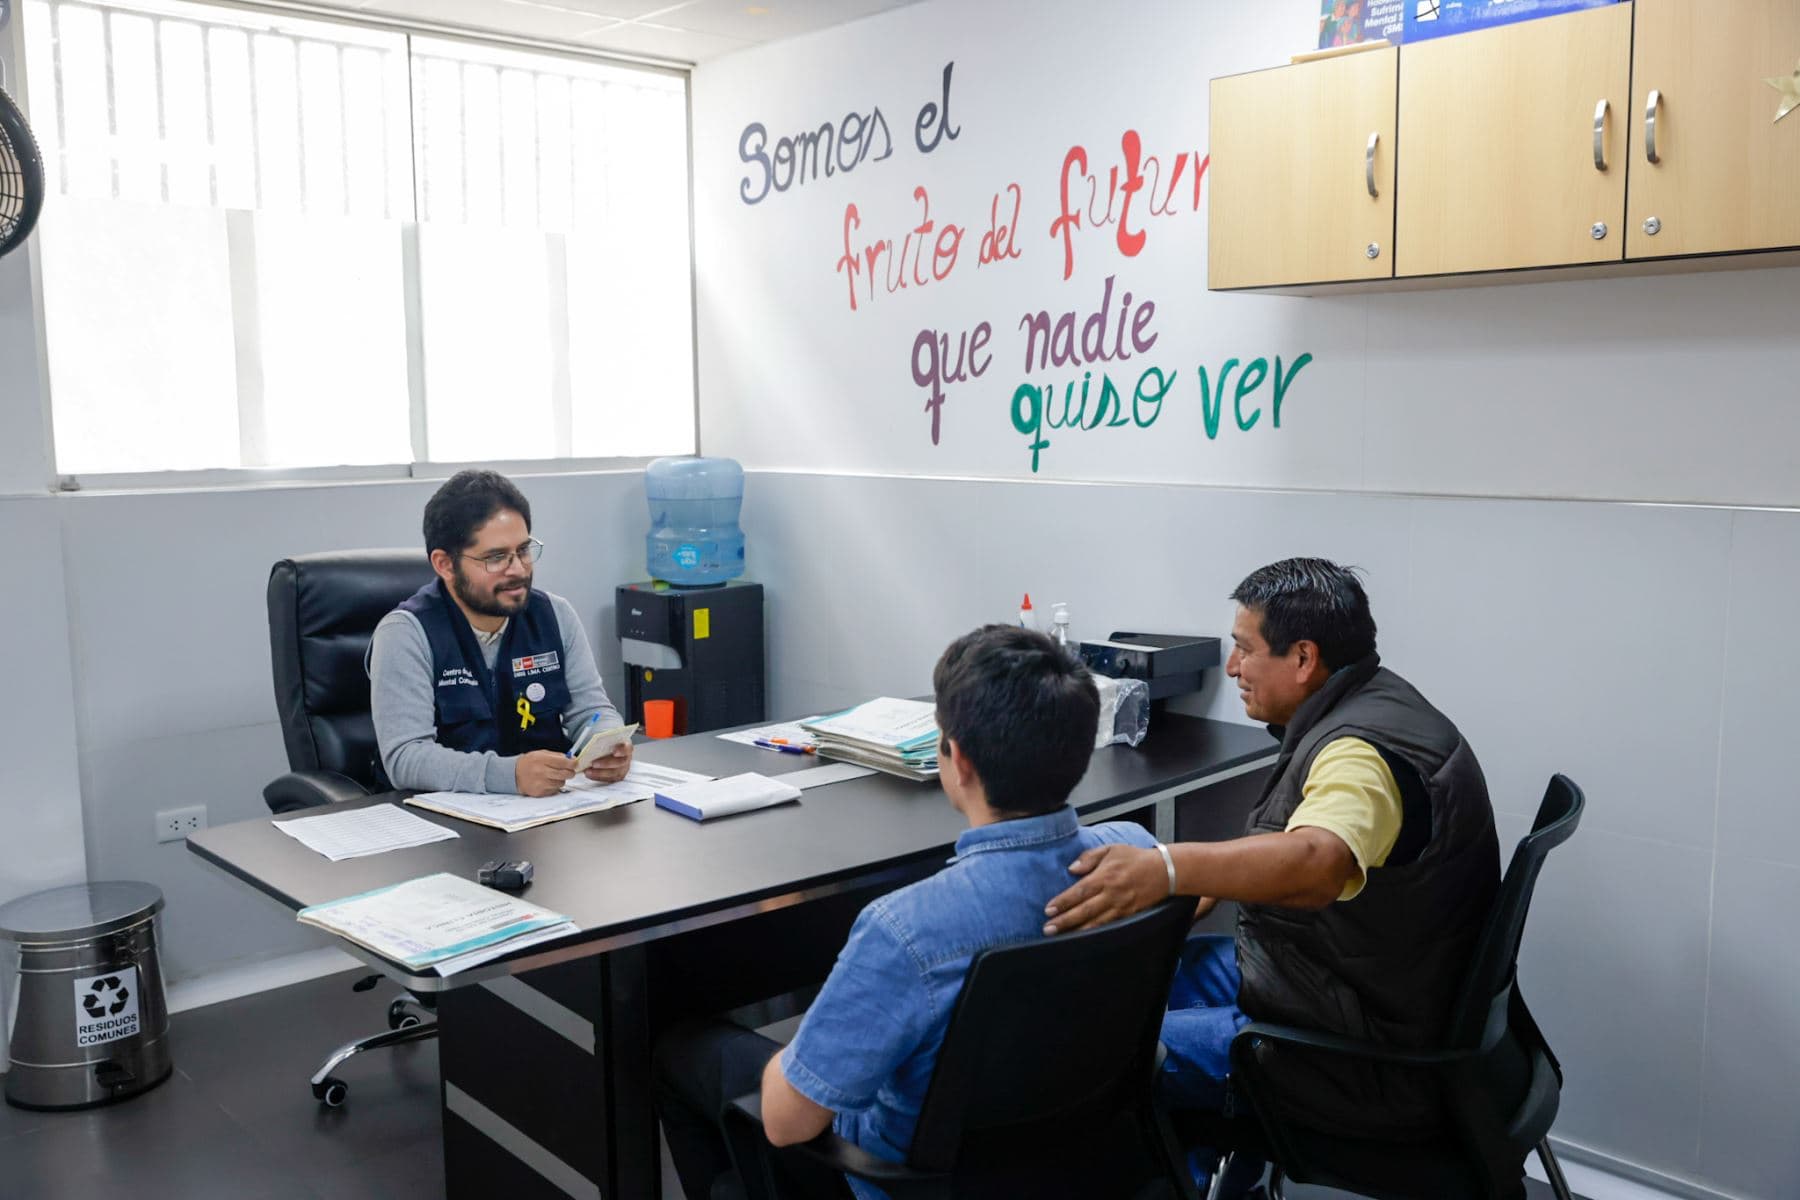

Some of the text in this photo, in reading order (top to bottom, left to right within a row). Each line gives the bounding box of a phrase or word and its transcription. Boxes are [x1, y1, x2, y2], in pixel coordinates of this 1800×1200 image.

[1364, 13, 1397, 29] Mental
[739, 61, 961, 206] Somos el
[837, 186, 966, 311] fruto
[978, 183, 1022, 269] del
[911, 275, 1159, 446] que nadie
[1011, 352, 1314, 473] quiso ver
[443, 669, 461, 677] Centro
[79, 1013, 137, 1035] RESIDUOS
[79, 1024, 137, 1045] COMUNES
